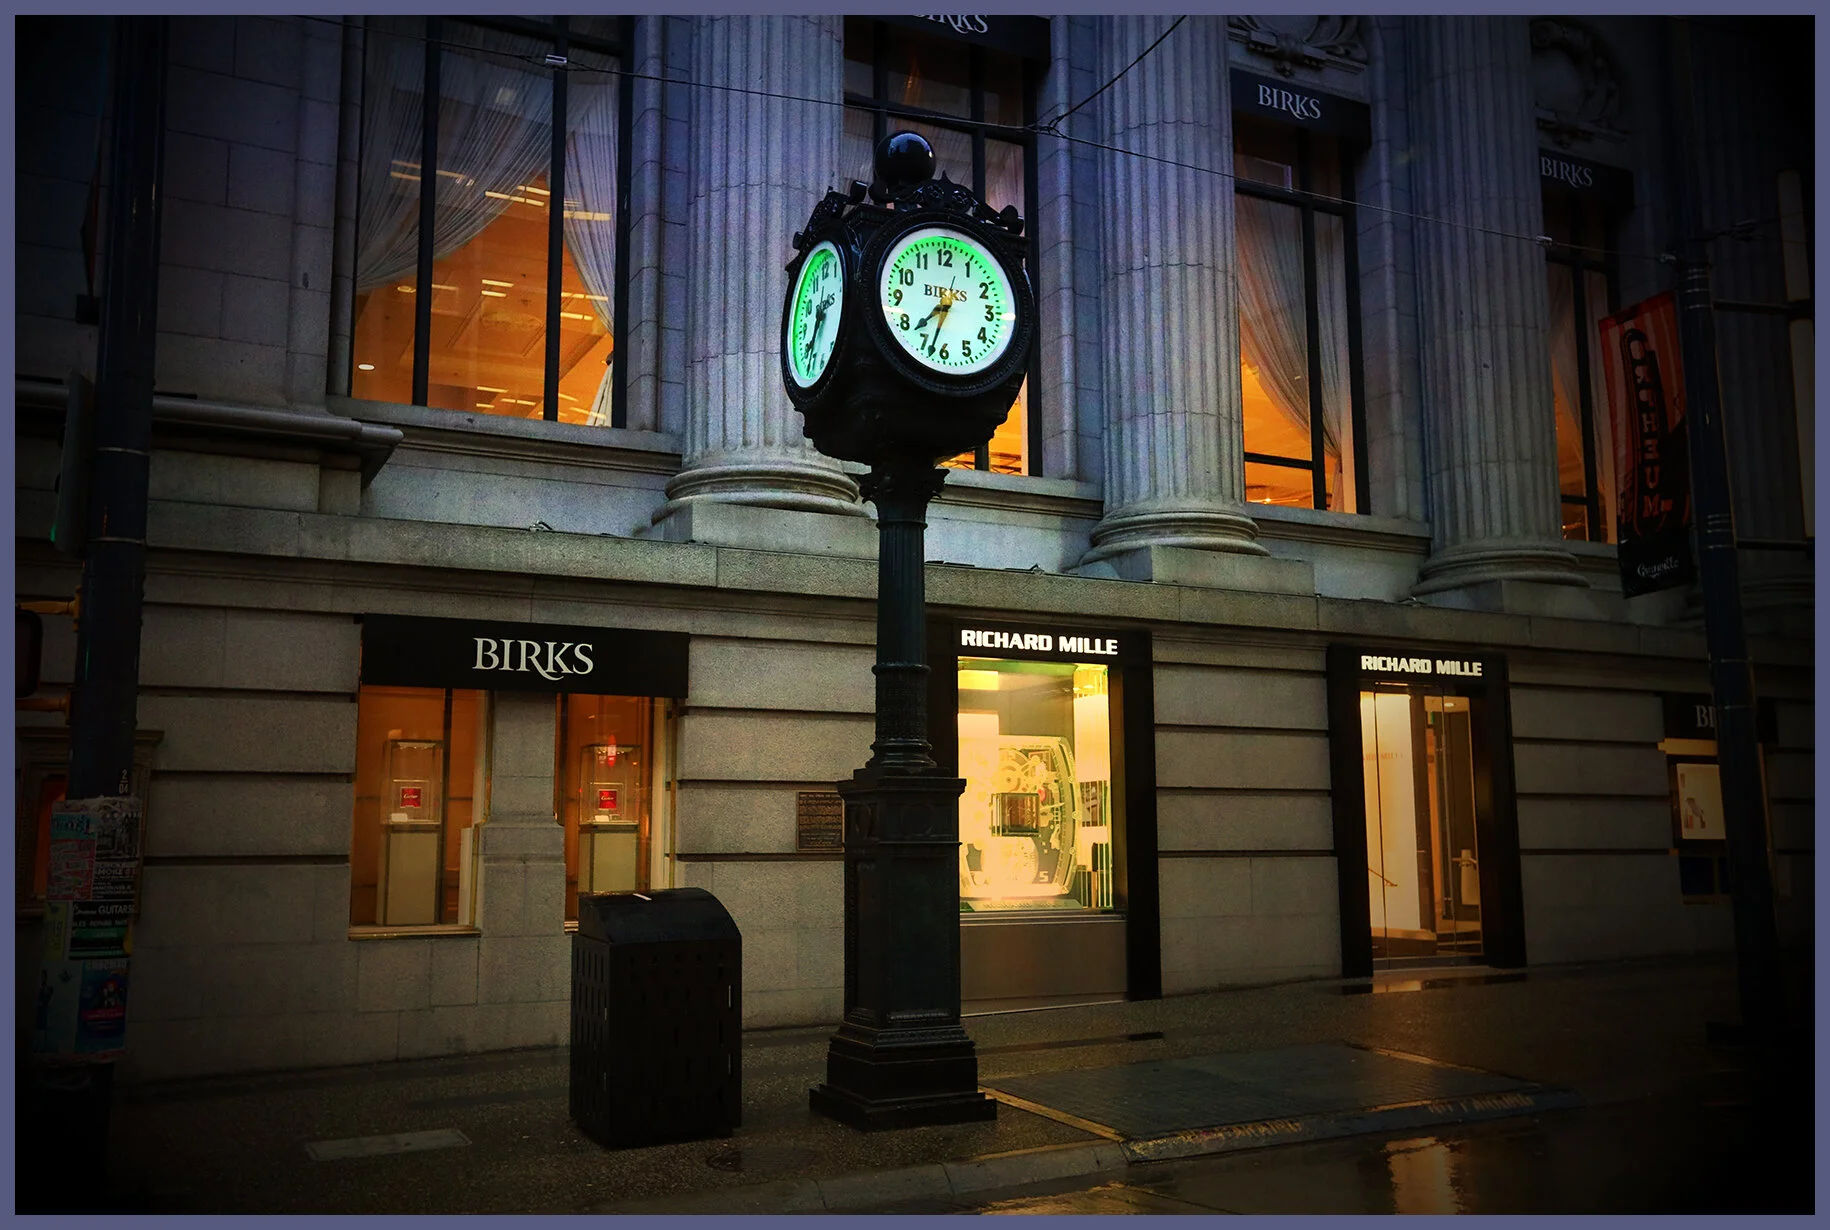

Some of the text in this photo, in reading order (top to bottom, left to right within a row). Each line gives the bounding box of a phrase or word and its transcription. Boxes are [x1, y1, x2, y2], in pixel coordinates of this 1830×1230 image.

[1257, 84, 1321, 120] BIRKS
[1541, 156, 1593, 188] BIRKS
[916, 252, 928, 270] 11
[937, 249, 953, 268] 12
[899, 268, 914, 287] 10
[965, 261, 971, 278] 1
[893, 289, 903, 306] 9
[924, 284, 967, 302] BIRKS
[979, 282, 989, 300] 2
[985, 304, 995, 322] 3
[900, 314, 910, 331] 8
[920, 333, 929, 351] 7
[977, 326, 988, 344] 4
[939, 343, 949, 360] 6
[962, 340, 972, 357] 5
[961, 629, 1119, 655] RICHARD MILLE
[472, 637, 594, 681] BIRKS
[1361, 655, 1483, 676] RICHARD MILLE
